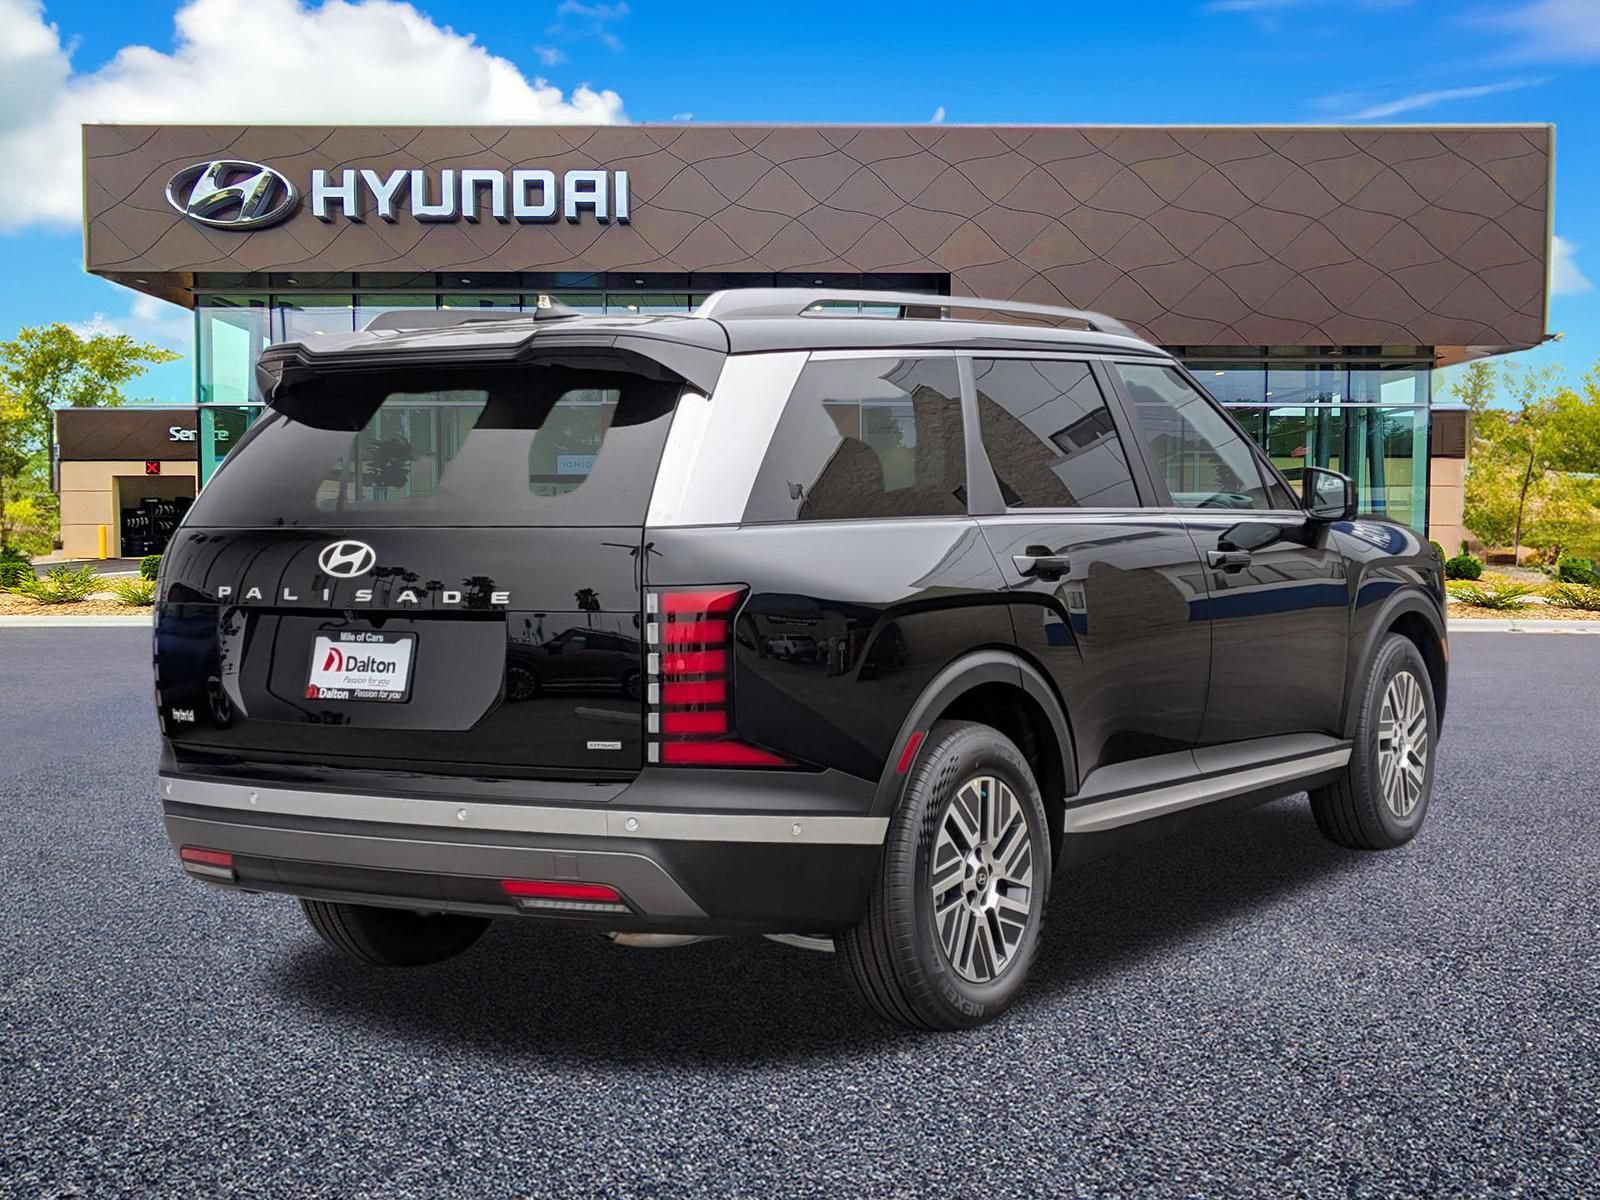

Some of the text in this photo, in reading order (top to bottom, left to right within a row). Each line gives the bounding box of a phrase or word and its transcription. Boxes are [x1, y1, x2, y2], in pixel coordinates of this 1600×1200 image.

[312, 169, 629, 221] HYUNDAI
[218, 586, 511, 605] PALISADE
[340, 632, 384, 642] Mile of Cars
[345, 656, 396, 673] Dalton
[319, 688, 402, 701] Dalton Passion for you
